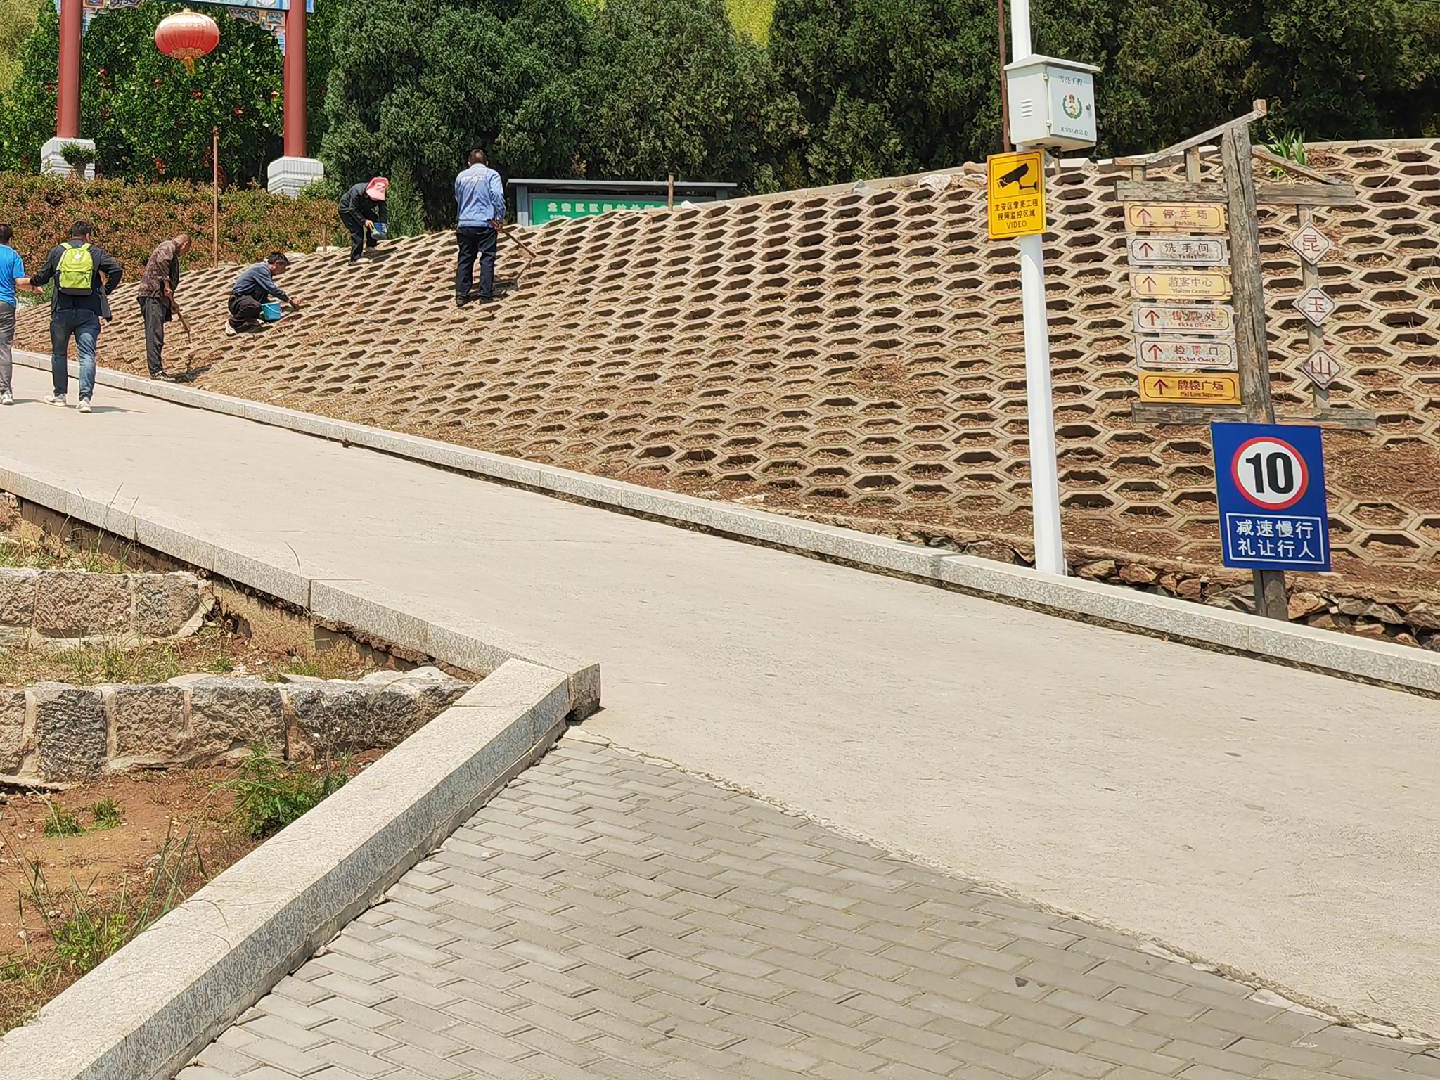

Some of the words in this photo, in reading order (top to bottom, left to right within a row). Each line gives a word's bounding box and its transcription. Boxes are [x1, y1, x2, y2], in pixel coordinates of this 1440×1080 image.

[1163, 208, 1209, 220] 停车场
[1006, 220, 1027, 229] VIDEO
[1164, 242, 1210, 253] 洗手间
[1168, 276, 1213, 288] 游客中心
[1174, 344, 1219, 356] 检票口
[1177, 379, 1224, 391] 牌楼广场
[1245, 452, 1294, 495] 10
[1235, 519, 1314, 540] 减速慢行
[1237, 538, 1316, 559] 礼让行人
